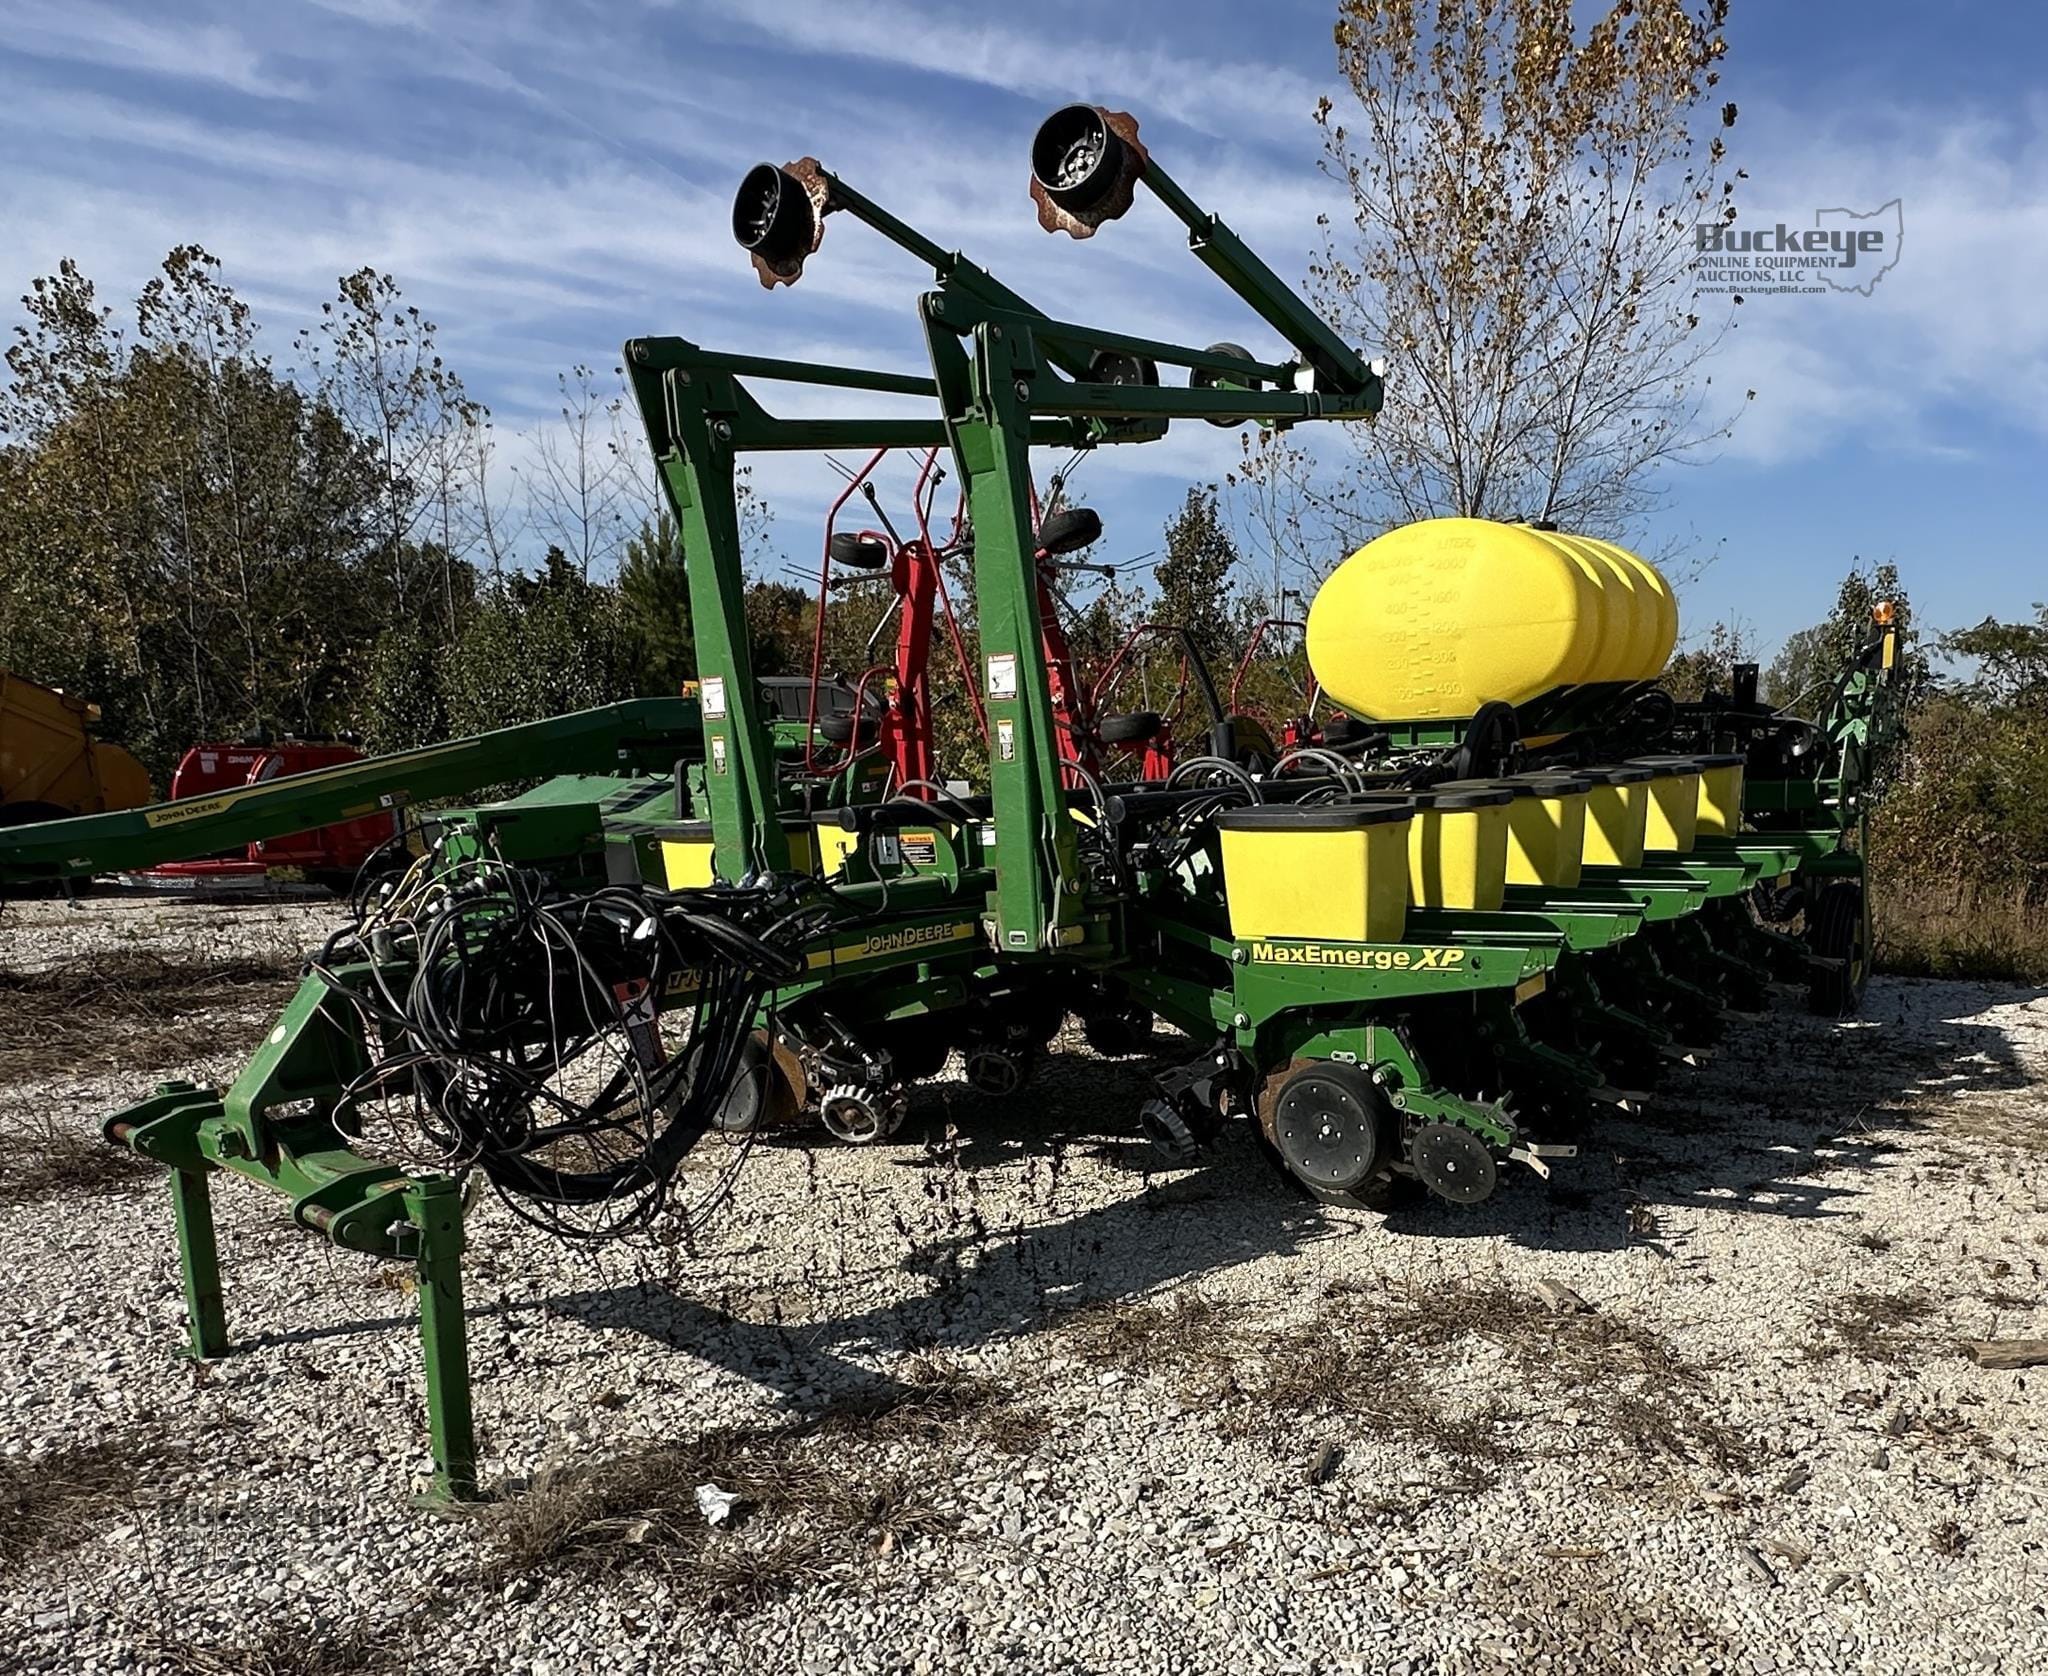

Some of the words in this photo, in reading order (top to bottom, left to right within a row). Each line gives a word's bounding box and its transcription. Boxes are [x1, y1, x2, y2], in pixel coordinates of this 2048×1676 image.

[155, 809, 185, 824] JOHN
[186, 801, 222, 815] DEERE
[862, 932, 904, 955] JOHN
[904, 922, 953, 946] DEERE
[1252, 943, 1411, 970] MaxEmerge
[1409, 948, 1465, 971] XP
